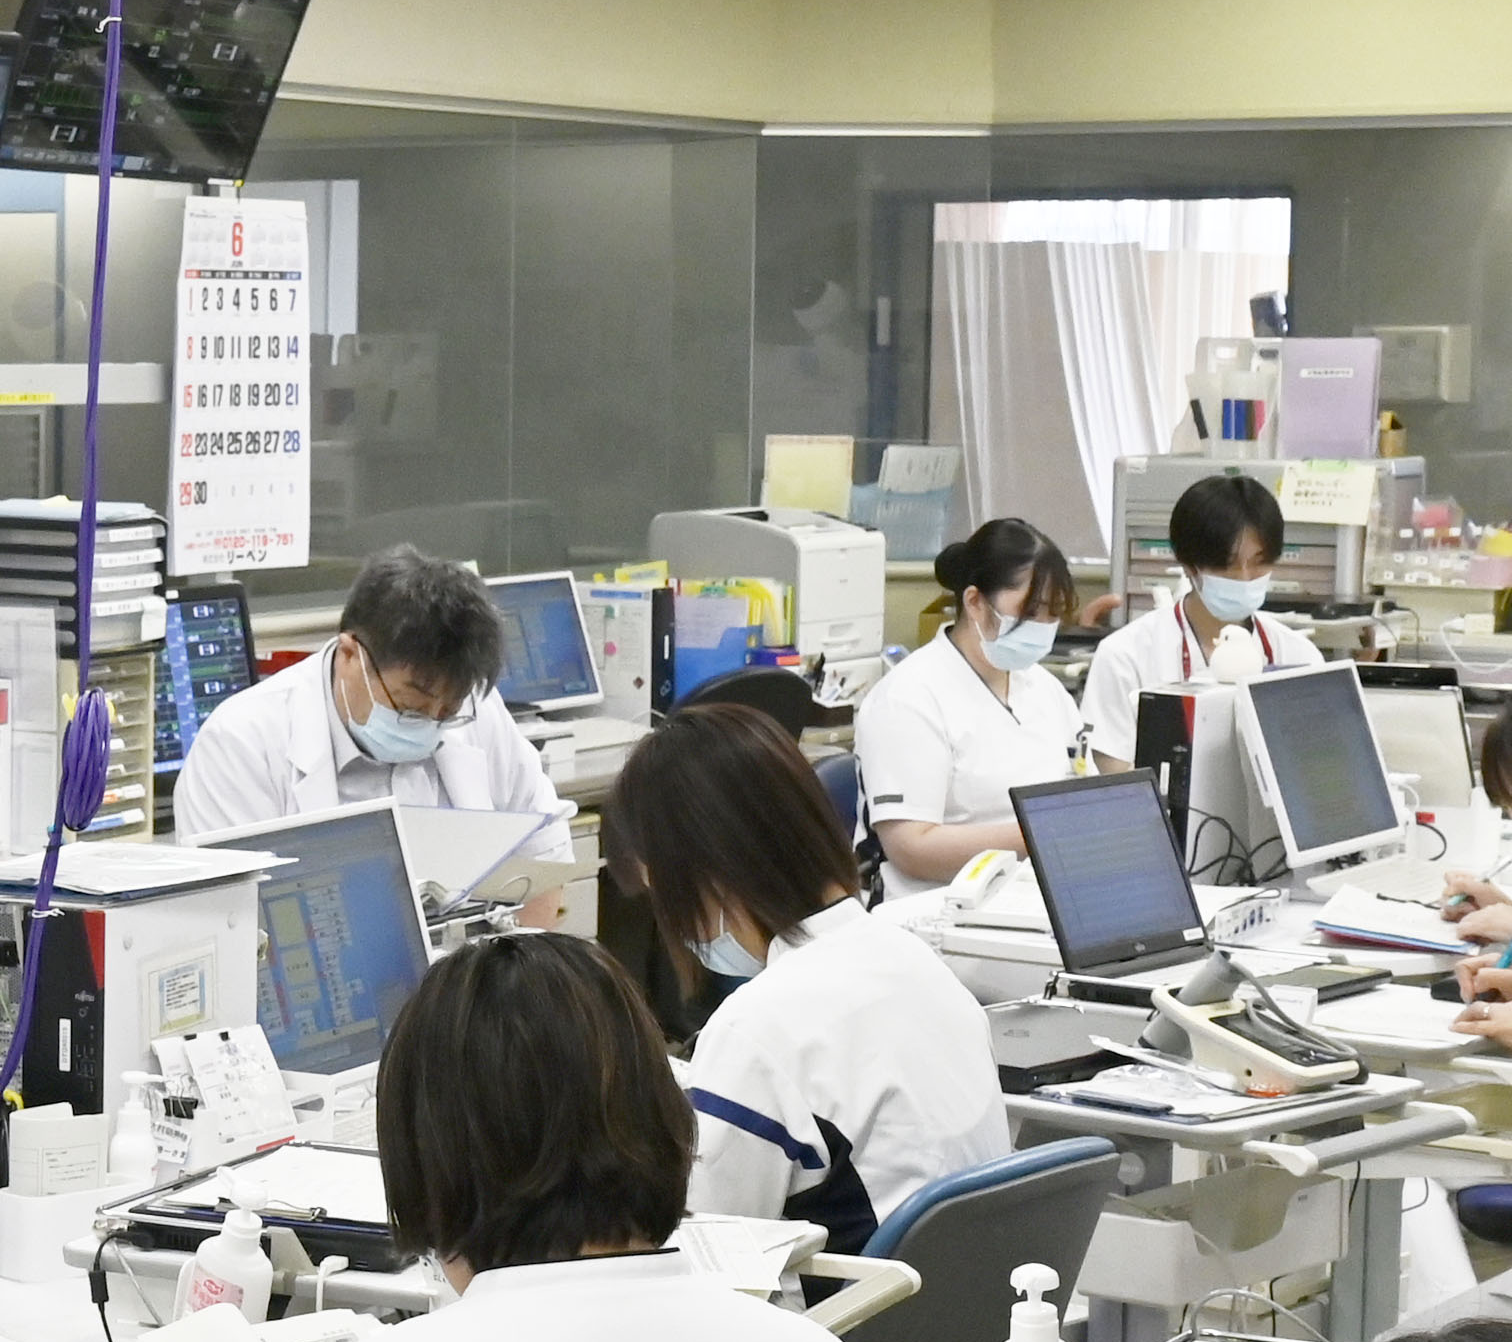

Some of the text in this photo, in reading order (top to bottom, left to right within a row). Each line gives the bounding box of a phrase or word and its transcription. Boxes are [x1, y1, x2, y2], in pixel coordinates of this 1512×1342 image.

[231, 222, 244, 257] 6
[188, 287, 297, 312] 1 2 3 4 5 6 7
[186, 335, 299, 360] 8 9 10 11 12 13 14
[183, 382, 299, 408] 15 16 17 18 19 20 21
[180, 430, 301, 457] 22 23 24 25 26 27 28
[179, 482, 192, 506] 29
[193, 481, 208, 505] 30
